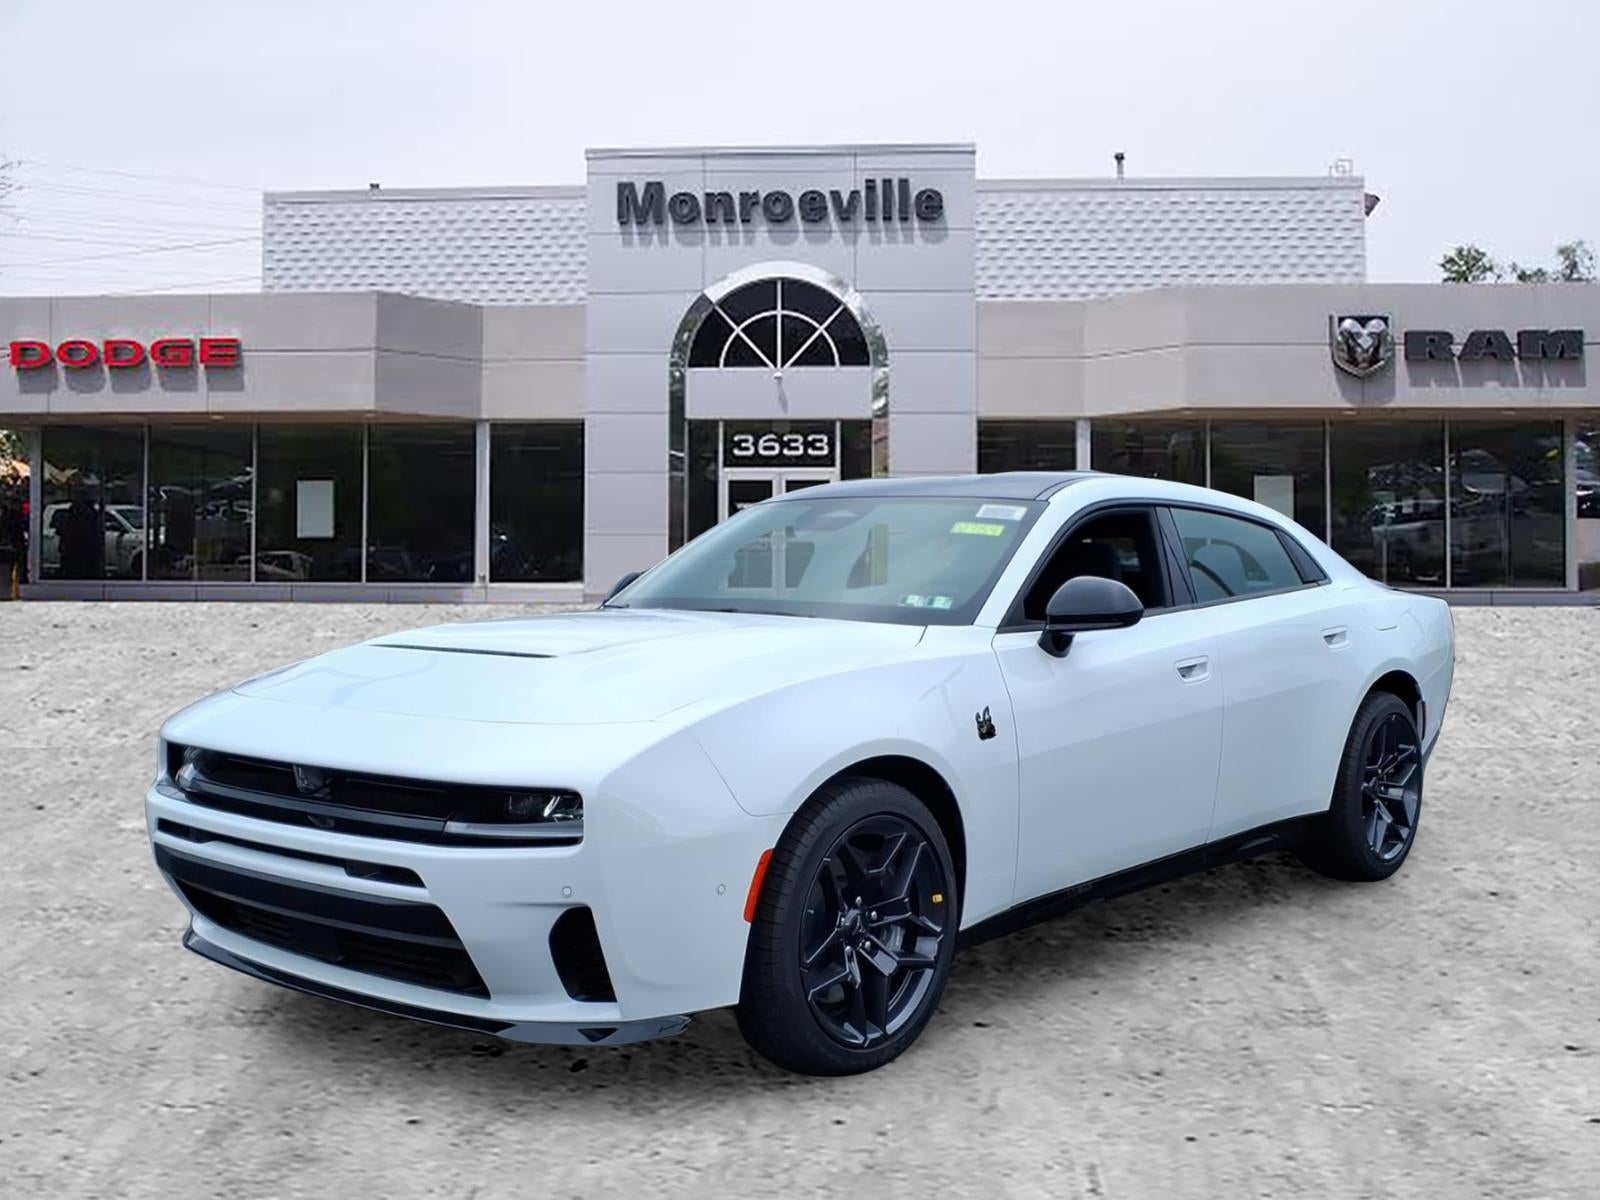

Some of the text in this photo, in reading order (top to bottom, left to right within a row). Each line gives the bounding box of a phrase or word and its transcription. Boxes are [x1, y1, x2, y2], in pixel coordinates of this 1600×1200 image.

[616, 177, 944, 225] Monroeville
[9, 338, 241, 367] DODGE
[1404, 329, 1584, 361] RAM
[732, 433, 829, 456] 3633
